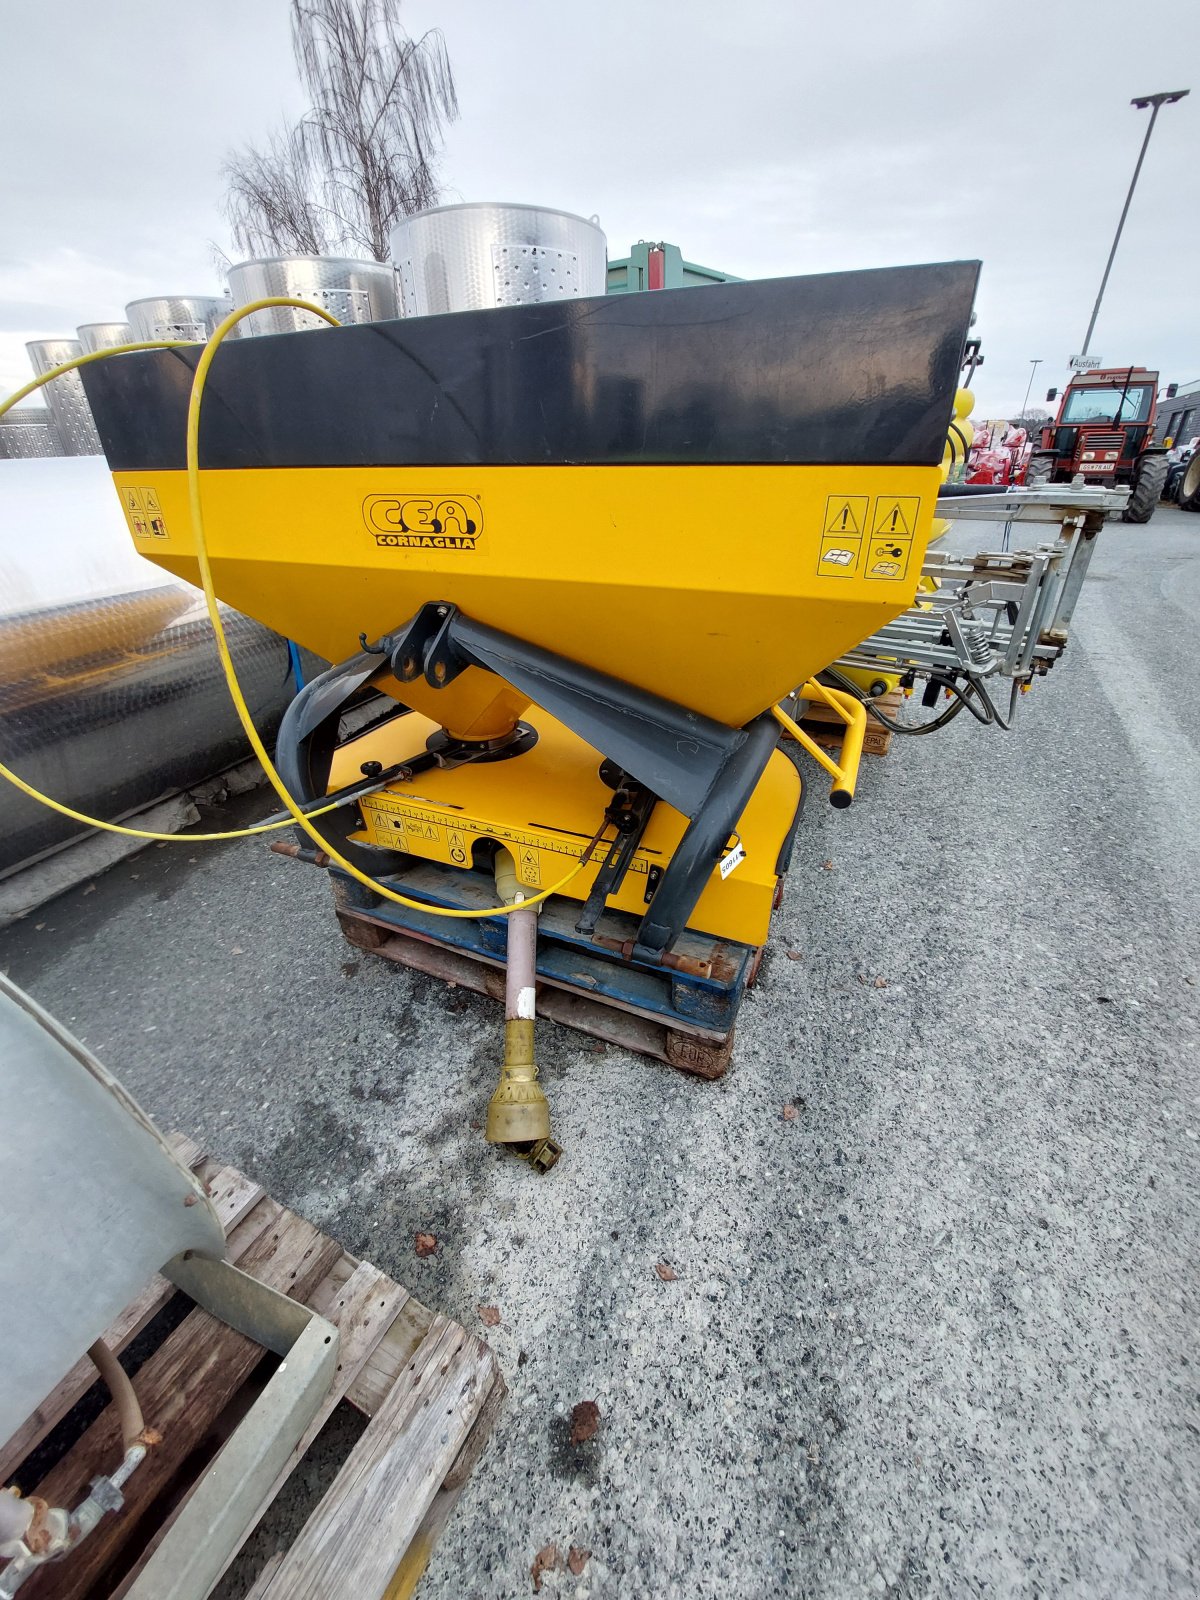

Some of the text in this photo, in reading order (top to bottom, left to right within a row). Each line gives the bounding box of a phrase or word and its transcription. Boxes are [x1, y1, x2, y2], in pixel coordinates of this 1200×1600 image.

[1073, 359, 1100, 369] Ausfahrt
[370, 500, 476, 534] CEA
[376, 535, 475, 550] CORNAGLIA
[721, 854, 739, 874] 11605
